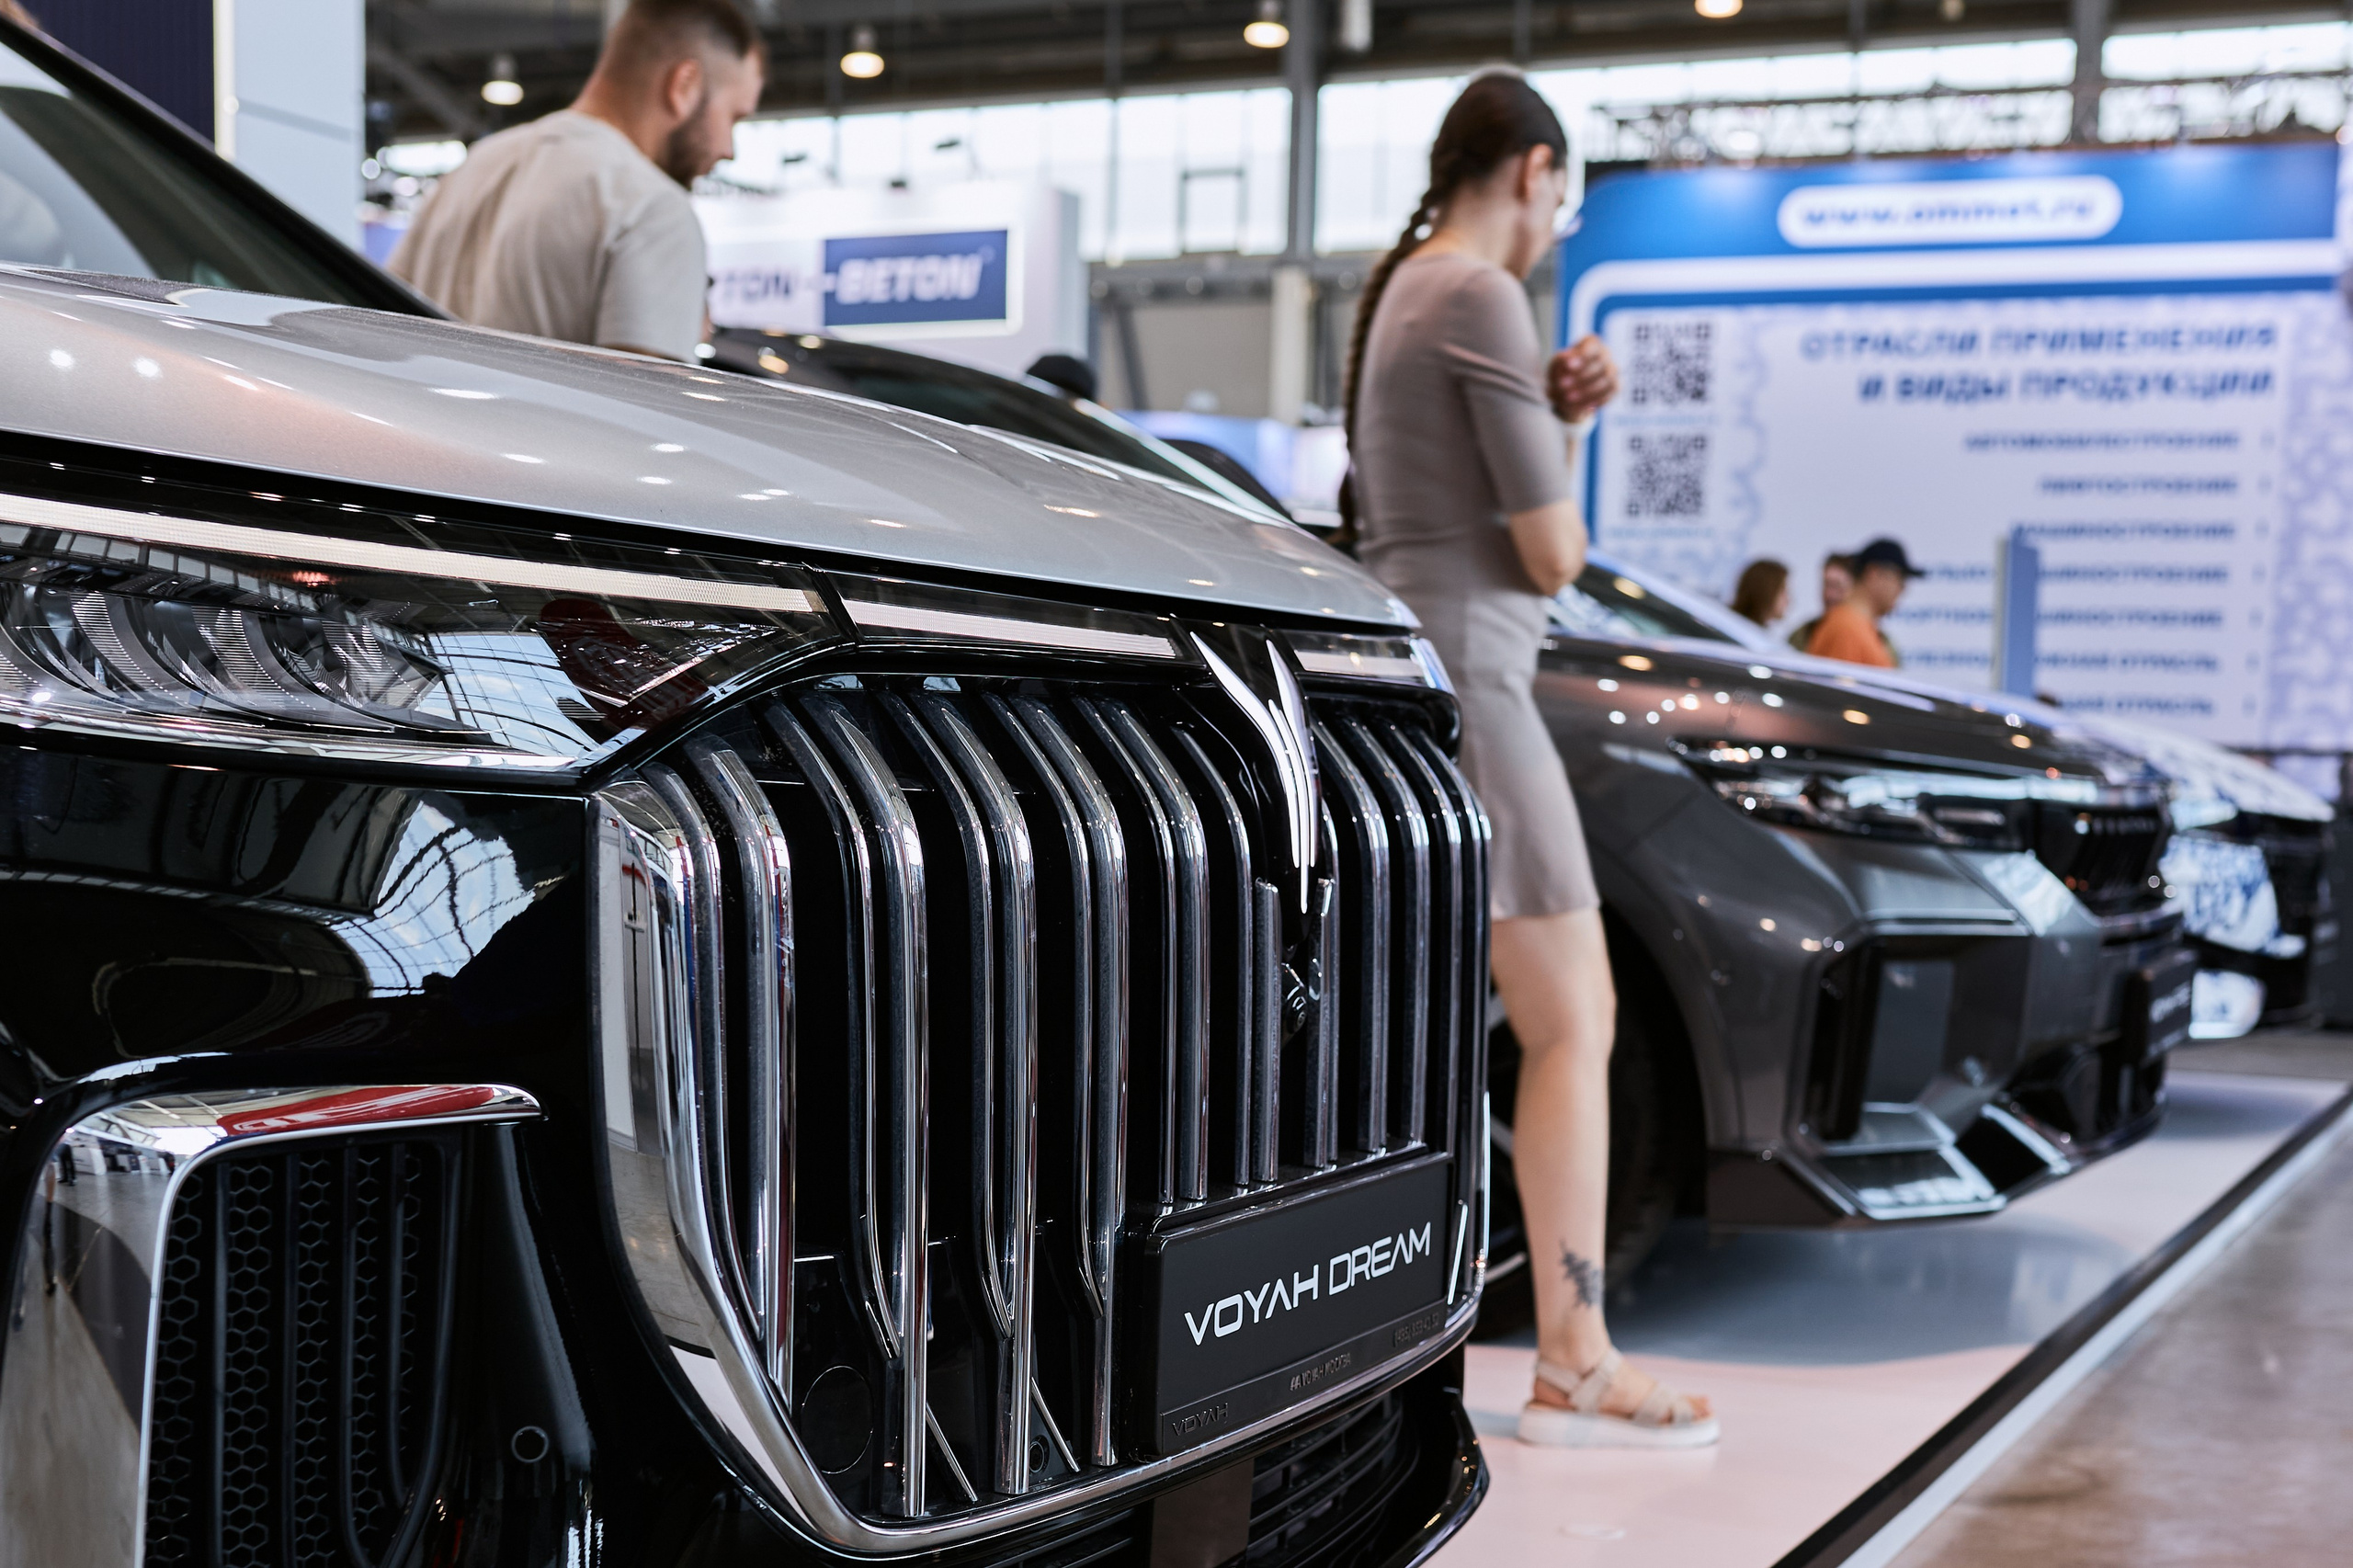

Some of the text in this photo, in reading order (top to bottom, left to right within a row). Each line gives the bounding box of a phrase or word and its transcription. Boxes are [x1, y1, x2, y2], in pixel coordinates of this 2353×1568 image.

[1799, 322, 2277, 361] ОТРАСЛИ ПРИМЕНЕНИЯ
[1894, 373, 2009, 404] ВИДЫ
[2020, 369, 2274, 401] ПРОДУКЦИИ
[1184, 1221, 1431, 1346] VOYAH DREAM
[1172, 1403, 1229, 1437] VOYAH
